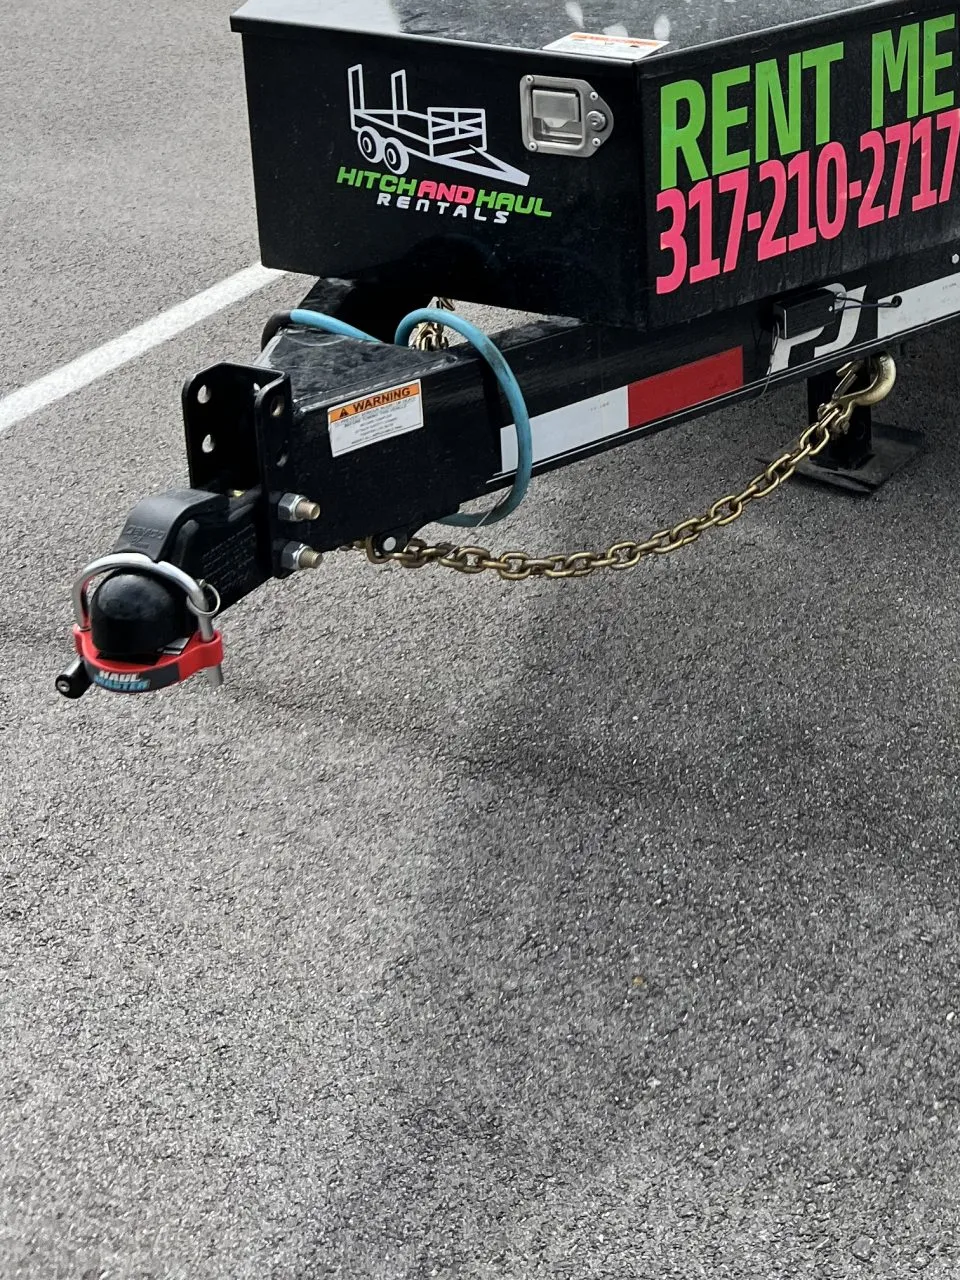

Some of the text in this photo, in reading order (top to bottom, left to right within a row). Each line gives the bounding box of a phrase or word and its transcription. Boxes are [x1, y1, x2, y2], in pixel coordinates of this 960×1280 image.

[660, 14, 956, 190] RENT ME
[376, 192, 510, 224] RENTALS
[353, 387, 411, 413] WARNING
[99, 670, 141, 683] HAUL
